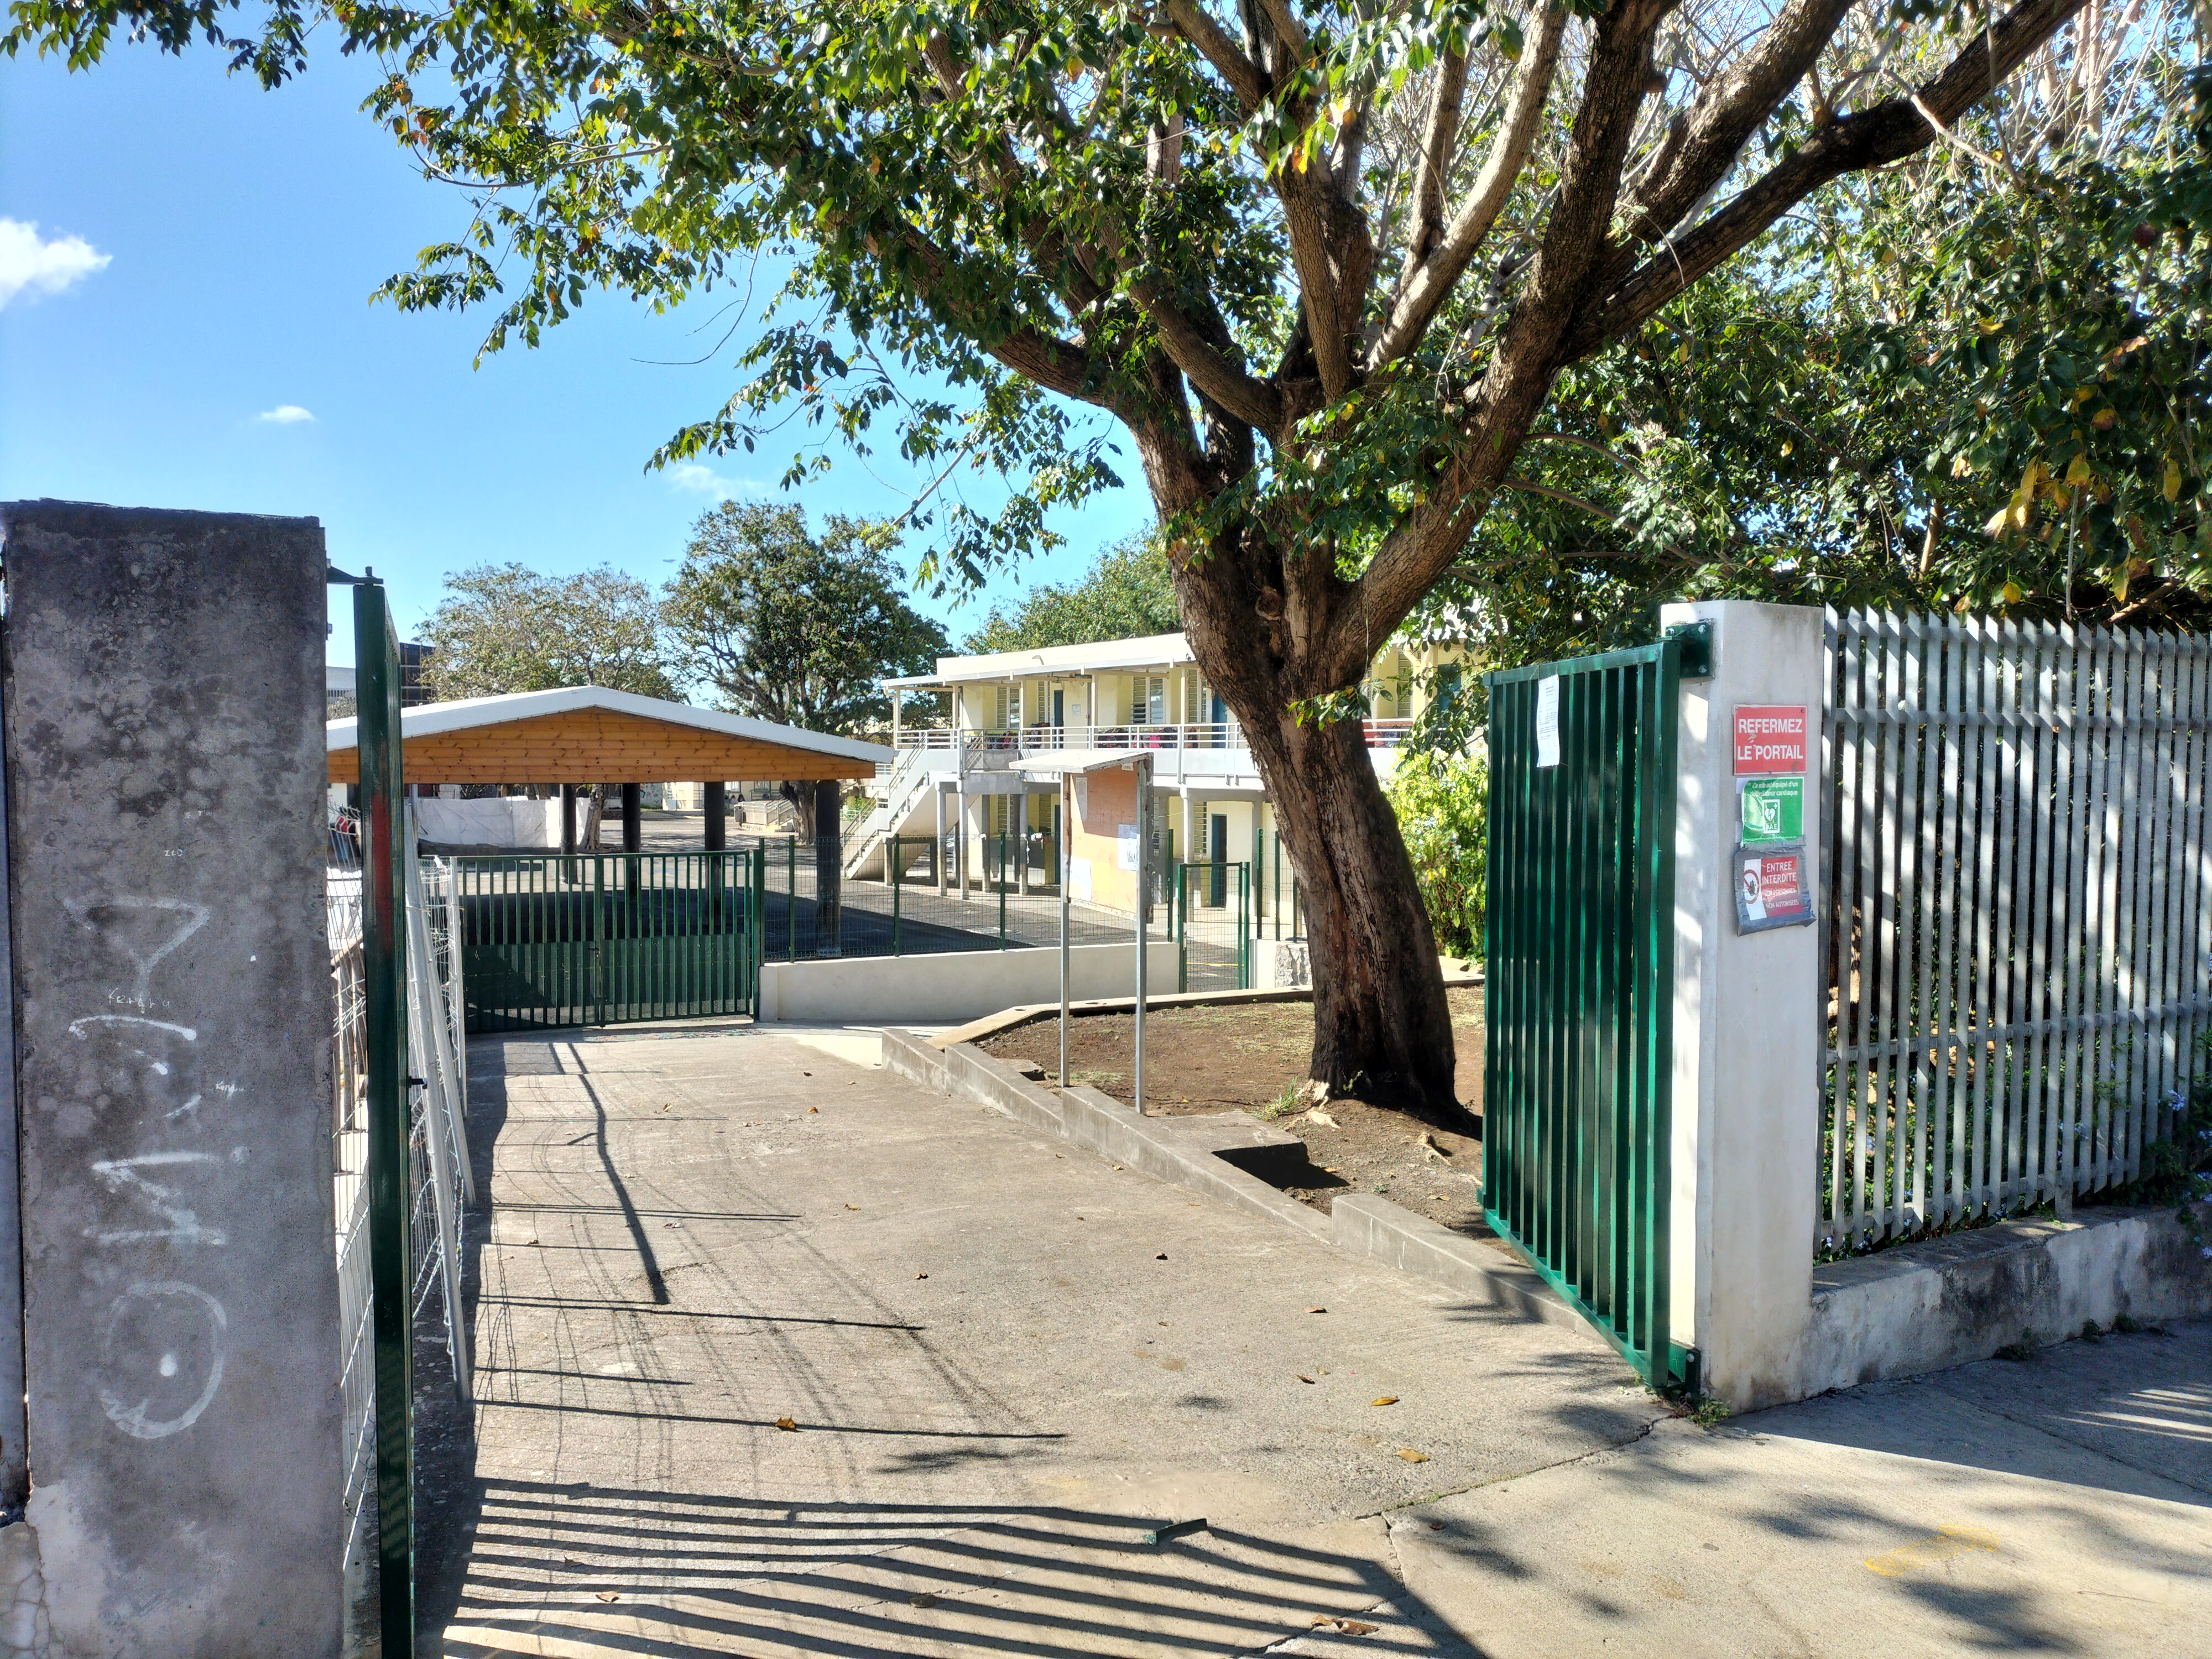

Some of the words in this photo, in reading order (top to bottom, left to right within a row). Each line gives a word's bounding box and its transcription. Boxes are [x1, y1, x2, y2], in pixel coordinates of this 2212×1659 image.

[1739, 718, 1803, 733] REFERMEZ
[1738, 745, 1752, 760] LE
[1755, 744, 1804, 760] PORTAIL
[1766, 861, 1793, 873] ENTREE
[1762, 872, 1797, 885] INTERDITE
